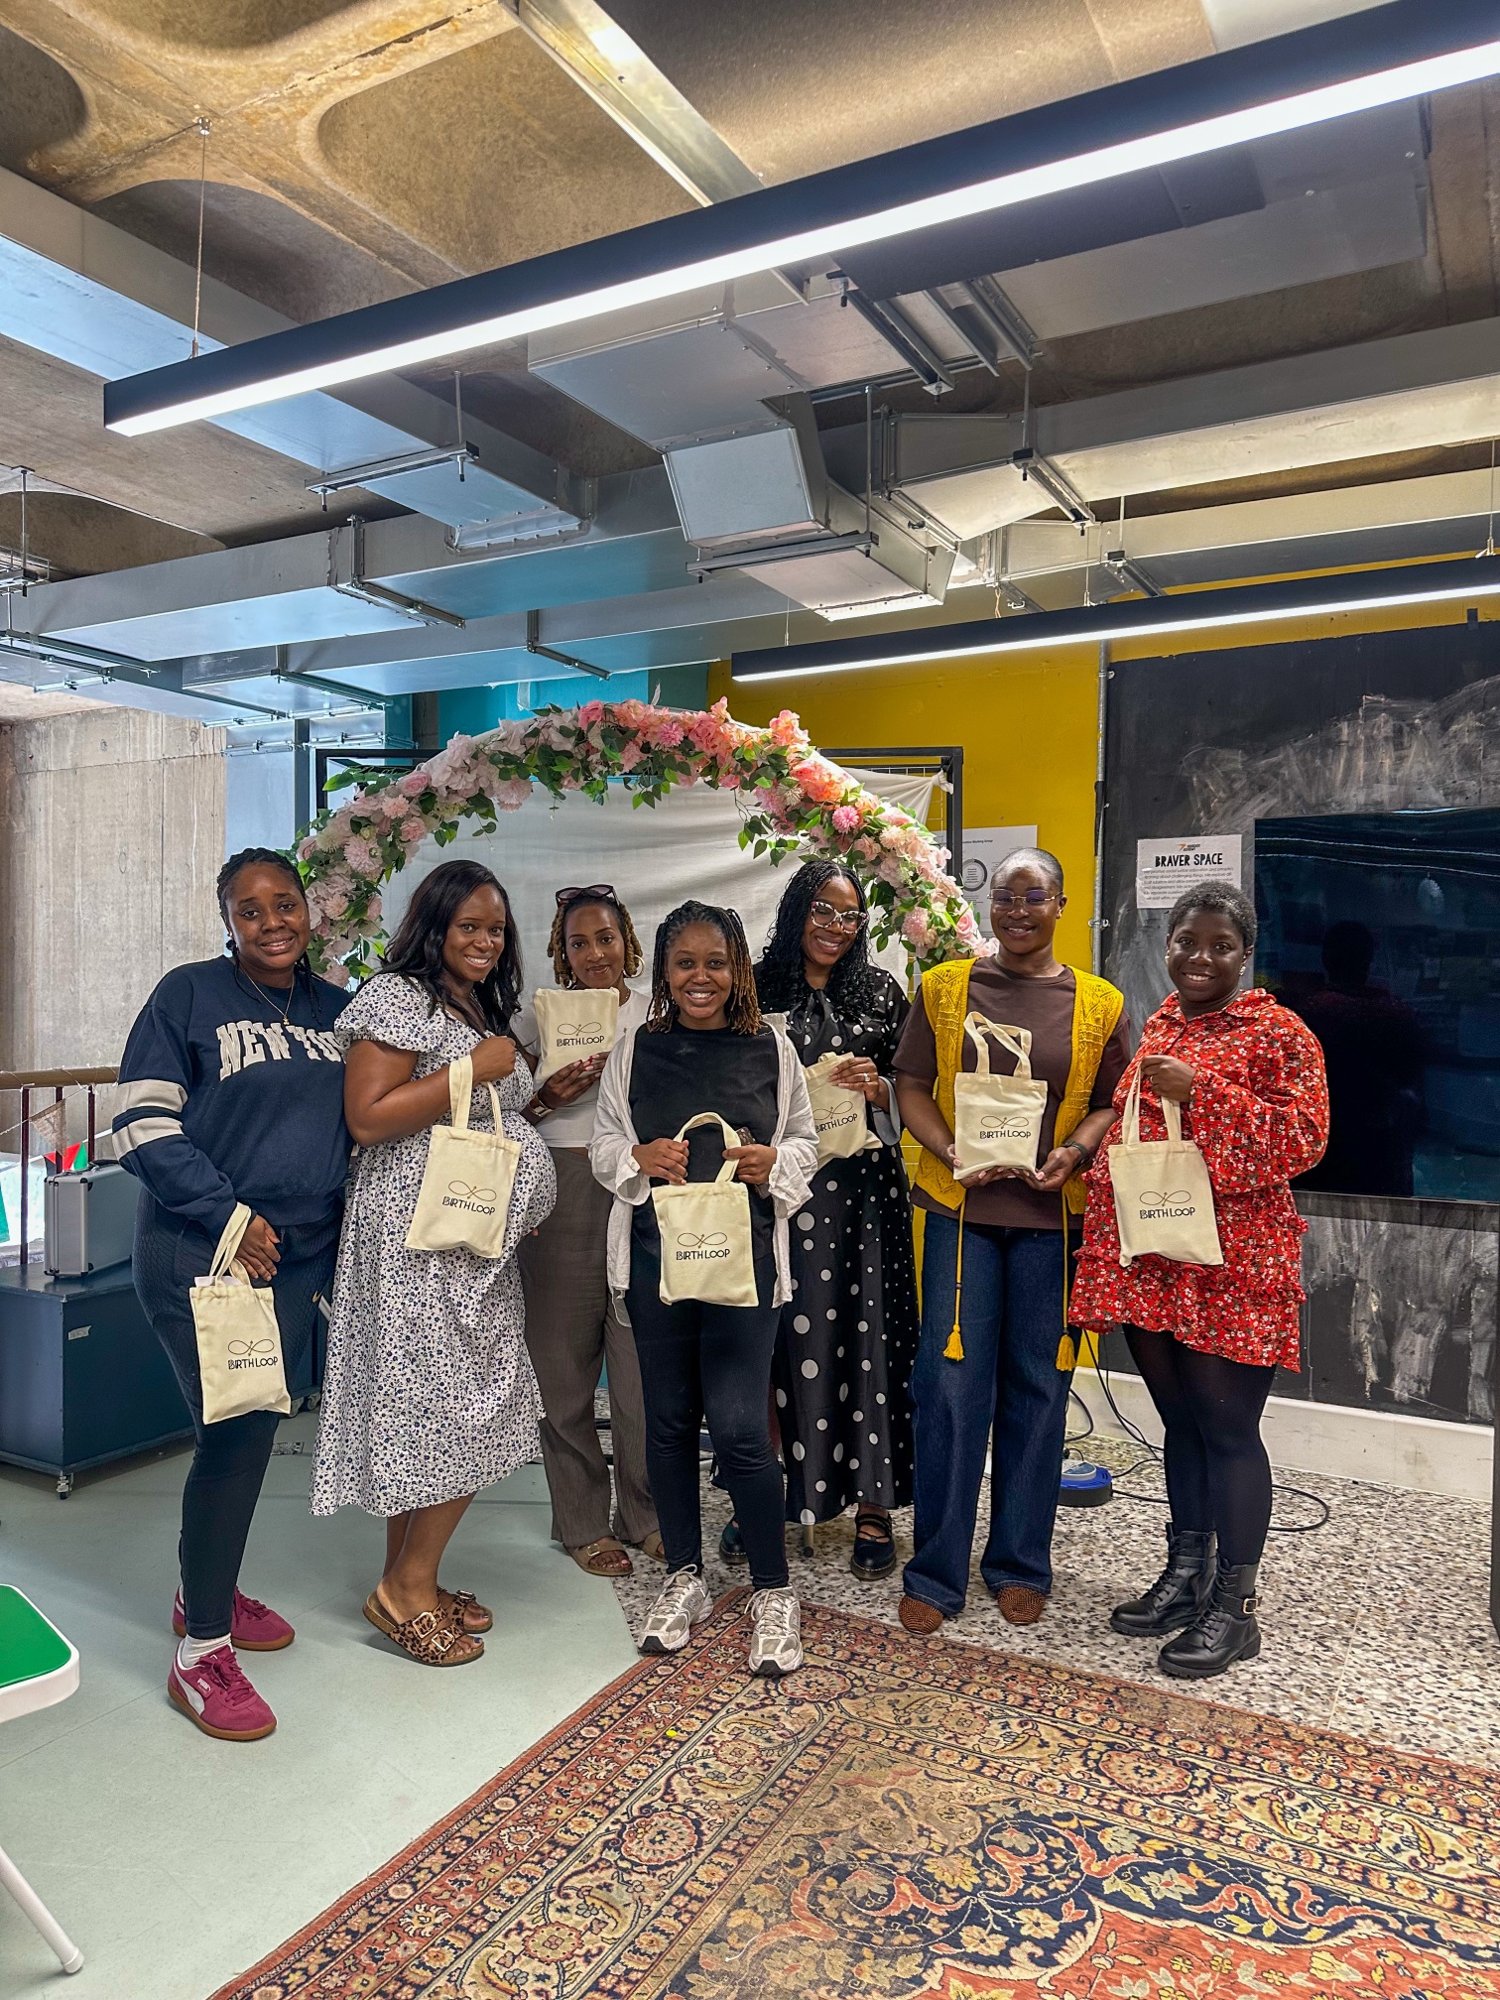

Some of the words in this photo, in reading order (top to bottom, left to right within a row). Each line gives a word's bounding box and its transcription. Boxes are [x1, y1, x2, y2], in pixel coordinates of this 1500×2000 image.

[1155, 854, 1190, 867] BRAVER
[1194, 853, 1223, 865] SPACE
[215, 1020, 292, 1082] NEW
[285, 1025, 346, 1064] YO
